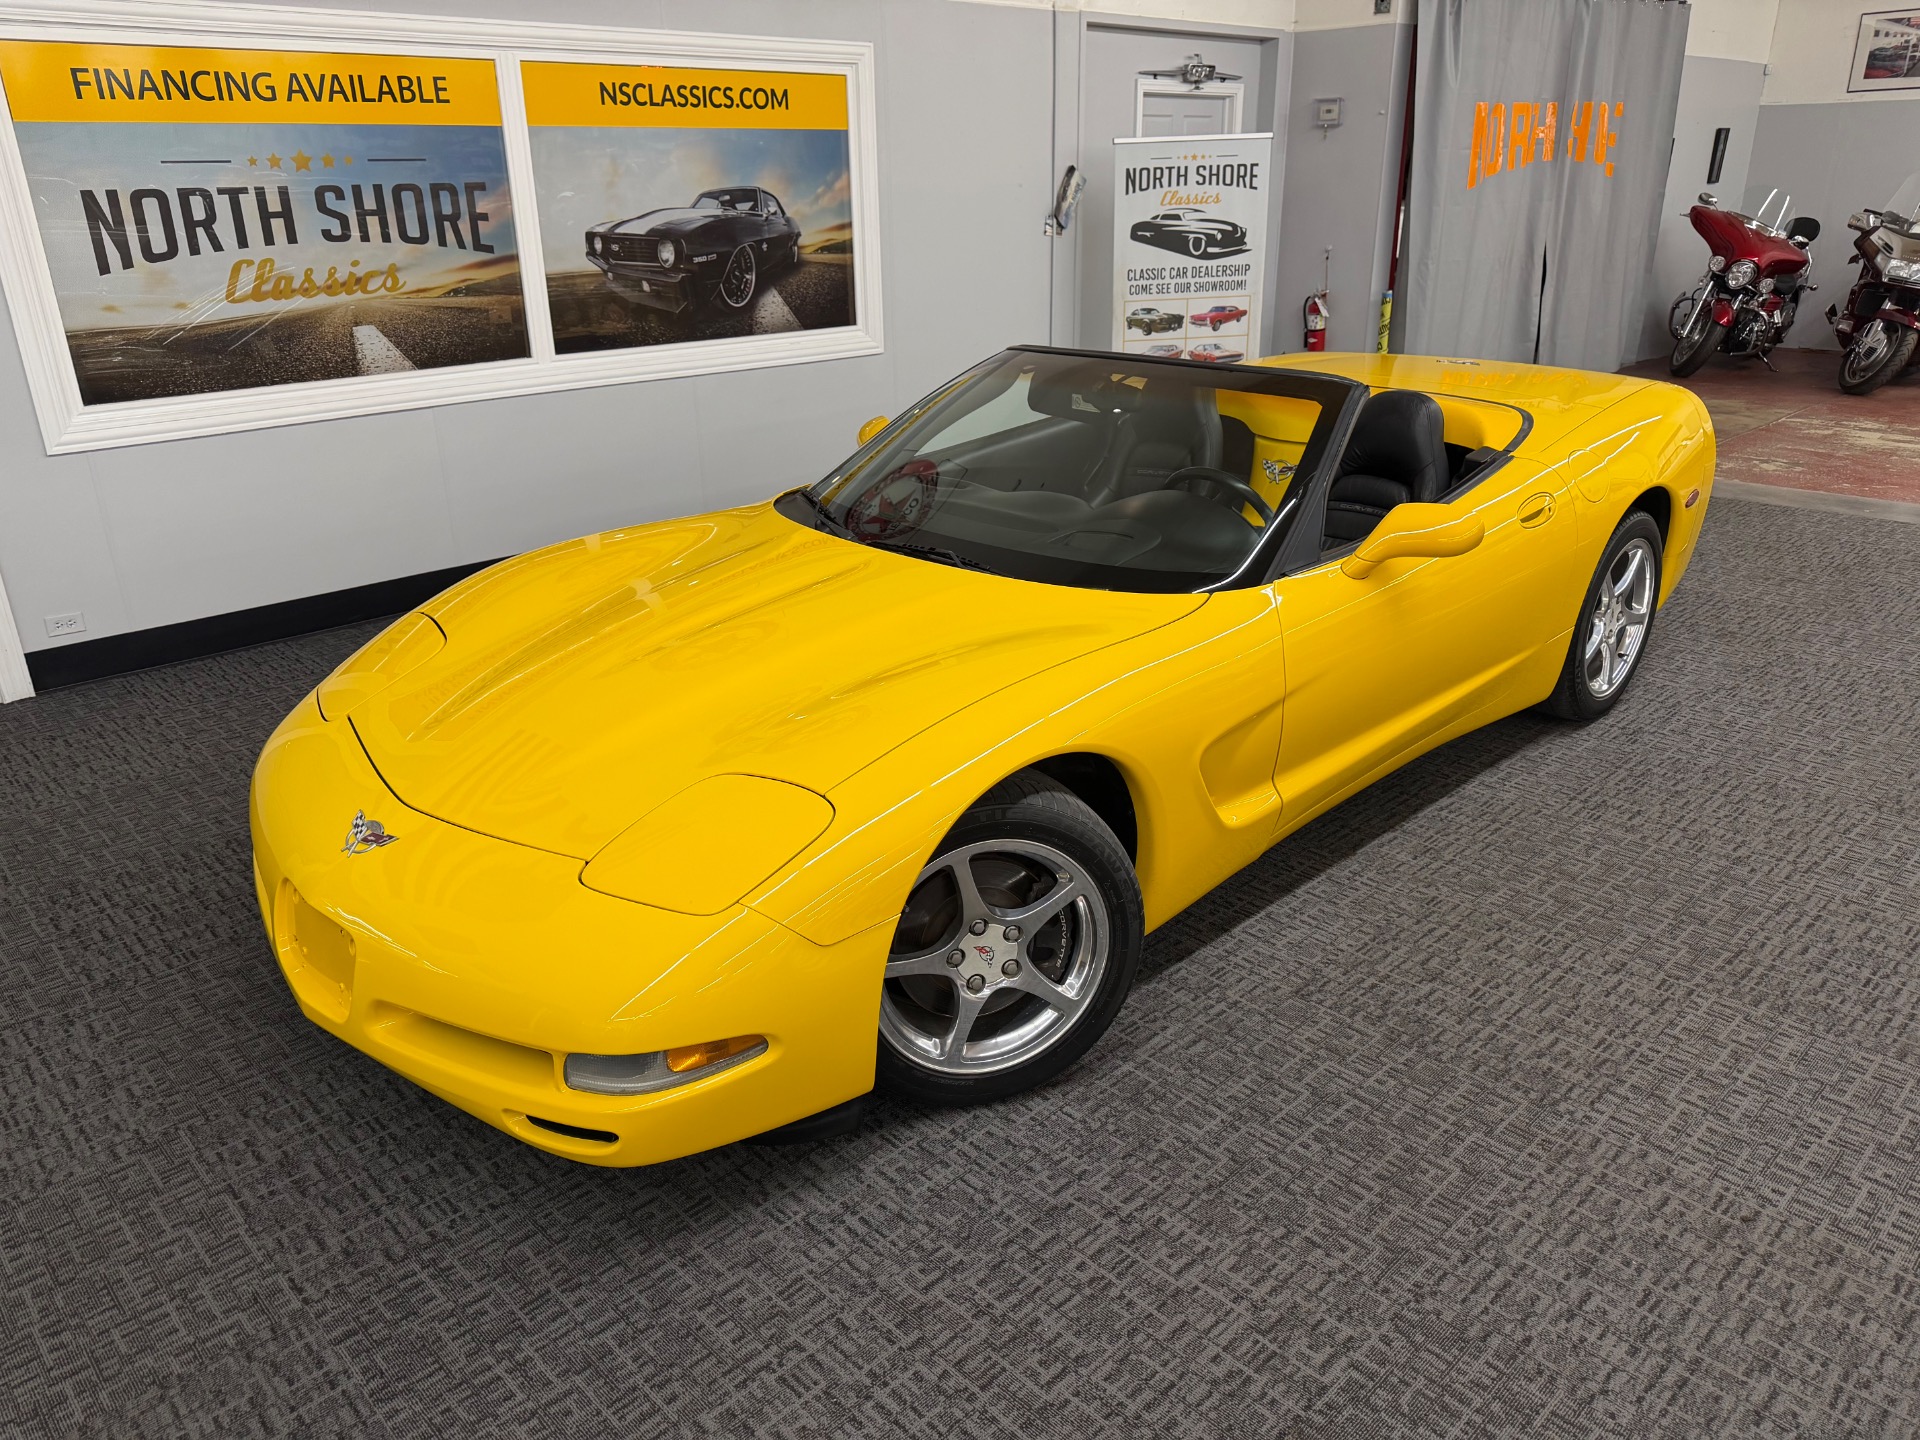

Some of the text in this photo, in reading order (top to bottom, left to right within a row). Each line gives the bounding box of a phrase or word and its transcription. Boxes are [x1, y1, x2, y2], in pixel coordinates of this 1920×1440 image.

[69, 67, 451, 105] FINANCING AVAILABLE
[599, 81, 789, 111] NSCLASSICS.COM
[1125, 162, 1259, 196] NORTH SHORE
[1160, 190, 1222, 207] Classics
[79, 181, 496, 277] NORTH SHORE
[224, 257, 408, 304] Classics
[1127, 263, 1251, 282] CLASSIC CAR DEALERSHIP
[1129, 279, 1247, 296] COME SEE OUR SHOWROOM!
